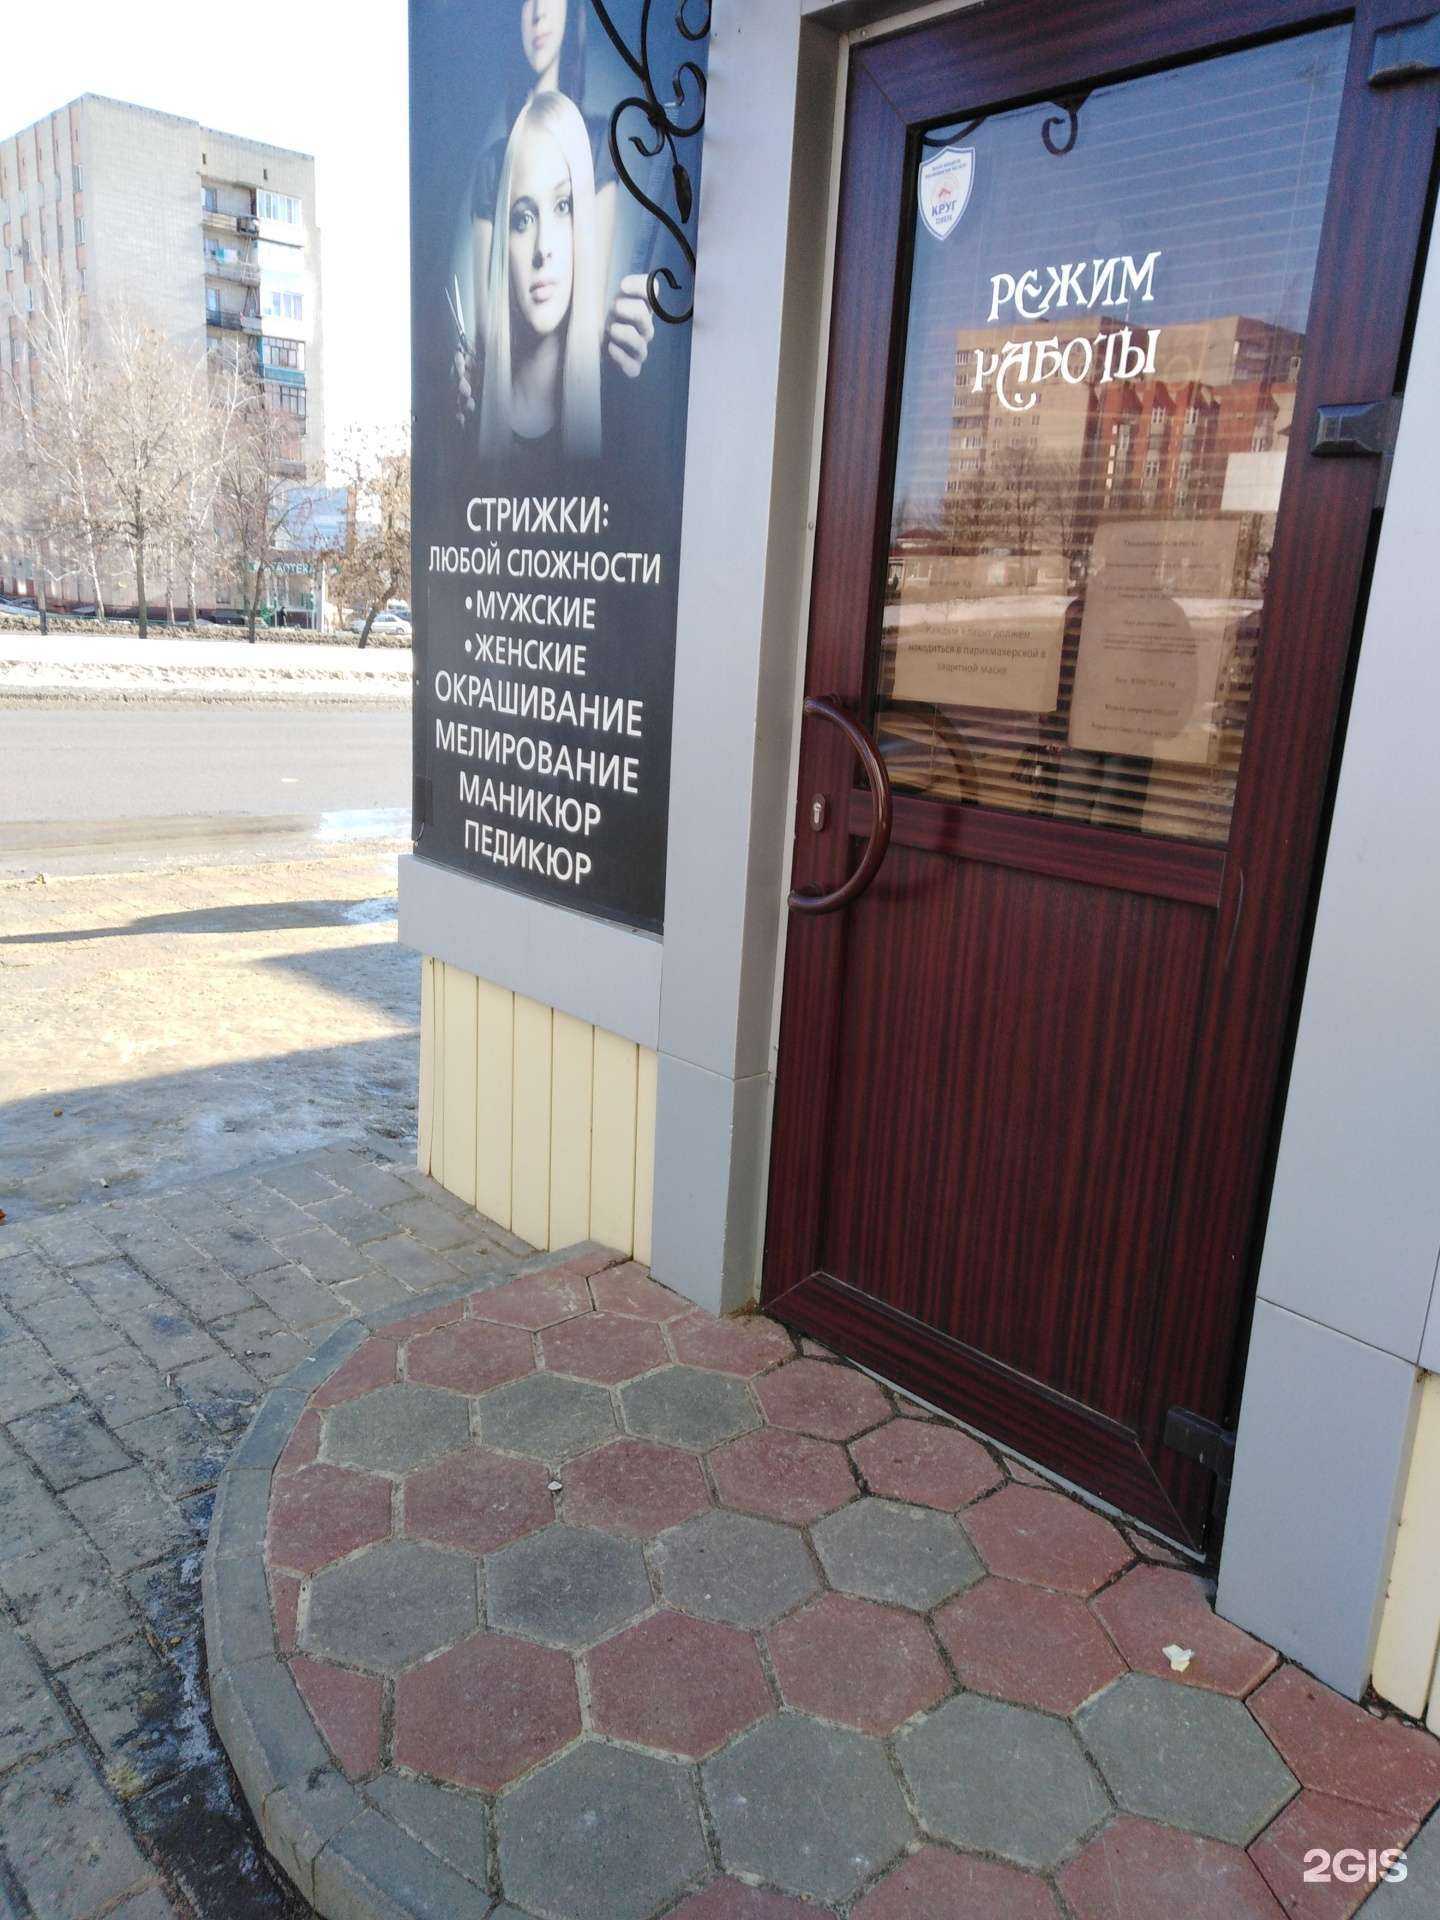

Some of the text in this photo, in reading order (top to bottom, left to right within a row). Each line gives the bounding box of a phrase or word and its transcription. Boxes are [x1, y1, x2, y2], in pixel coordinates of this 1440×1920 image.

[987, 251, 1162, 322] РЕЖИМ
[971, 326, 1161, 412] РАБОТЫ
[466, 496, 609, 533] СТРИЖКИ:
[428, 539, 662, 584] ЛЮБОЙ СЛОЖНОСТИ
[476, 590, 596, 629] МУЖСКИЕ
[474, 632, 587, 676] ЖЕНСКИЕ
[434, 670, 644, 737] ОКРАШИВАНИЕ
[434, 718, 640, 794] МЕЛИРОВАНИЕ
[459, 770, 602, 836] МАНИКЮР
[464, 819, 592, 885] ПЕДИКЮР
